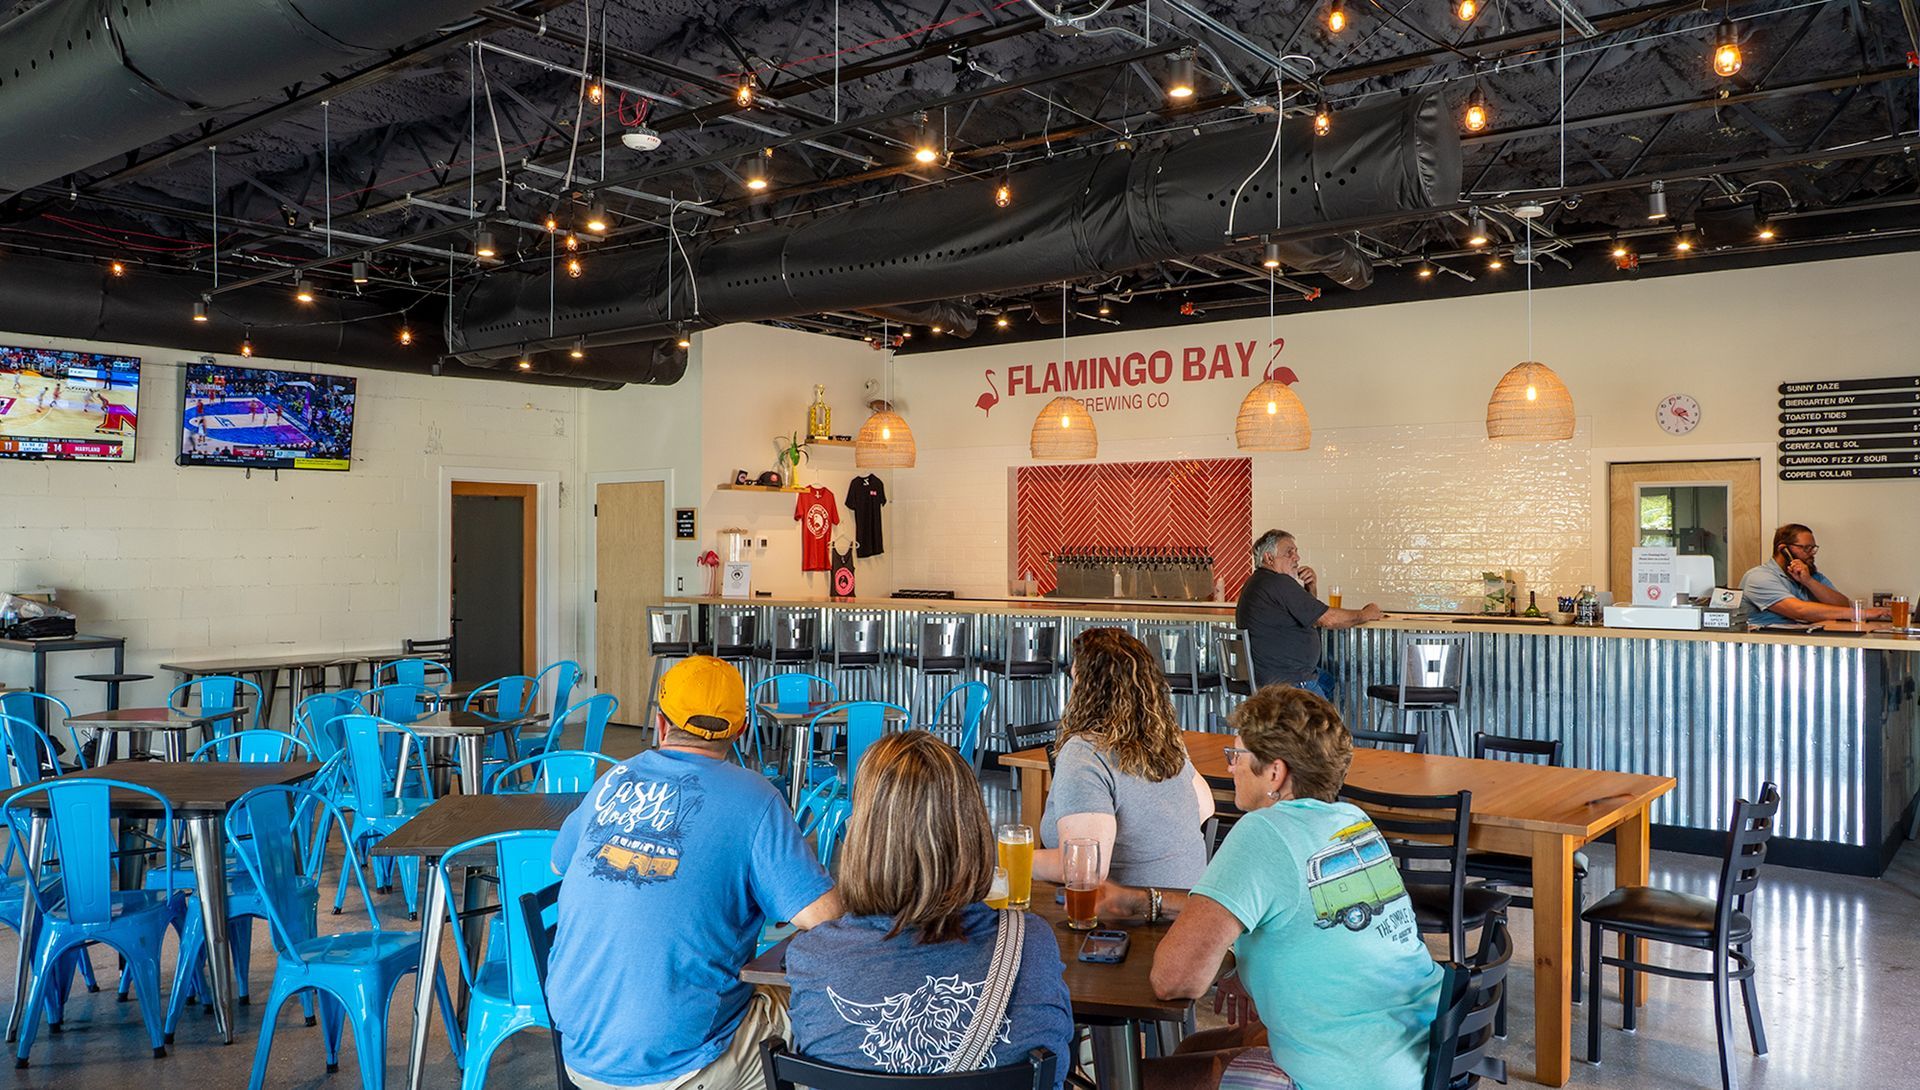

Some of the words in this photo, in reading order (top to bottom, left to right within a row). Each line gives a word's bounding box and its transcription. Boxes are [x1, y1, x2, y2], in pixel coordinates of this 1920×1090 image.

[1008, 350, 1173, 396] FLAMINGO
[1182, 340, 1257, 382] BAY
[1786, 384, 1815, 393] SUNNY
[1816, 382, 1840, 391] DAZE
[1147, 391, 1170, 409] CO
[1785, 397, 1836, 407] BIERGARTEN
[1838, 396, 1856, 404] BAY
[1785, 412, 1822, 421] TOASTED
[1823, 411, 1847, 419] TIDES
[1785, 427, 1812, 436] BEACH
[1815, 426, 1838, 434] FOAM
[4, 441, 12, 450] 11
[53, 443, 62, 452] 14
[1785, 441, 1822, 450] CERVEZA
[1823, 441, 1840, 449] DEL
[1842, 440, 1860, 448] SOL
[1786, 456, 1829, 465] FLAMINGO
[1831, 455, 1853, 463] FIZZ
[1863, 454, 1888, 463] SOUR
[1785, 470, 1817, 479] COPPER
[1819, 469, 1852, 478] COLLAR
[595, 765, 677, 820] Easy
[598, 801, 640, 833] does
[651, 808, 675, 832] it
[1375, 917, 1394, 938] THE
